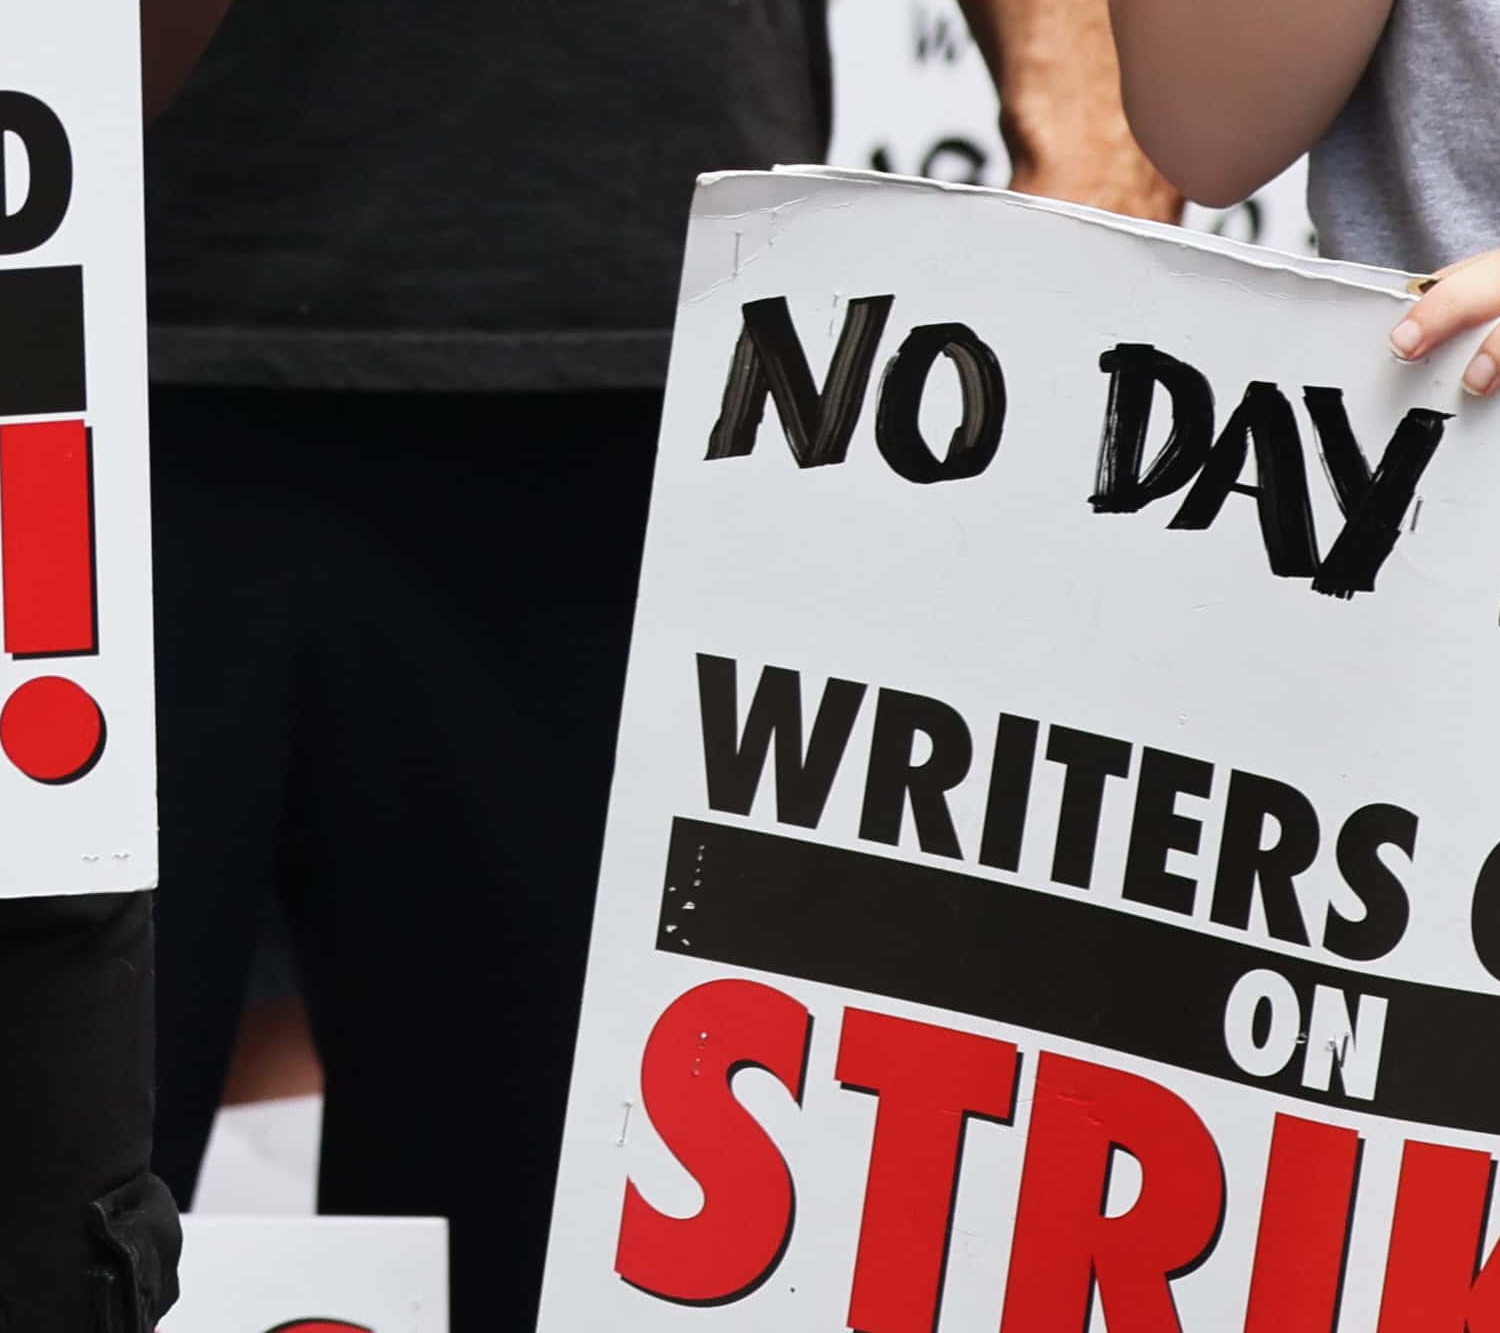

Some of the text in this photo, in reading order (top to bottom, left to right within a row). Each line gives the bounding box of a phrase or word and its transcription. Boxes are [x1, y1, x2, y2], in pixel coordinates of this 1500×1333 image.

[704, 292, 1006, 485] NO
[1088, 341, 1456, 597] DAY
[694, 653, 1421, 962] WRITERS
[1221, 967, 1388, 1103] ON
